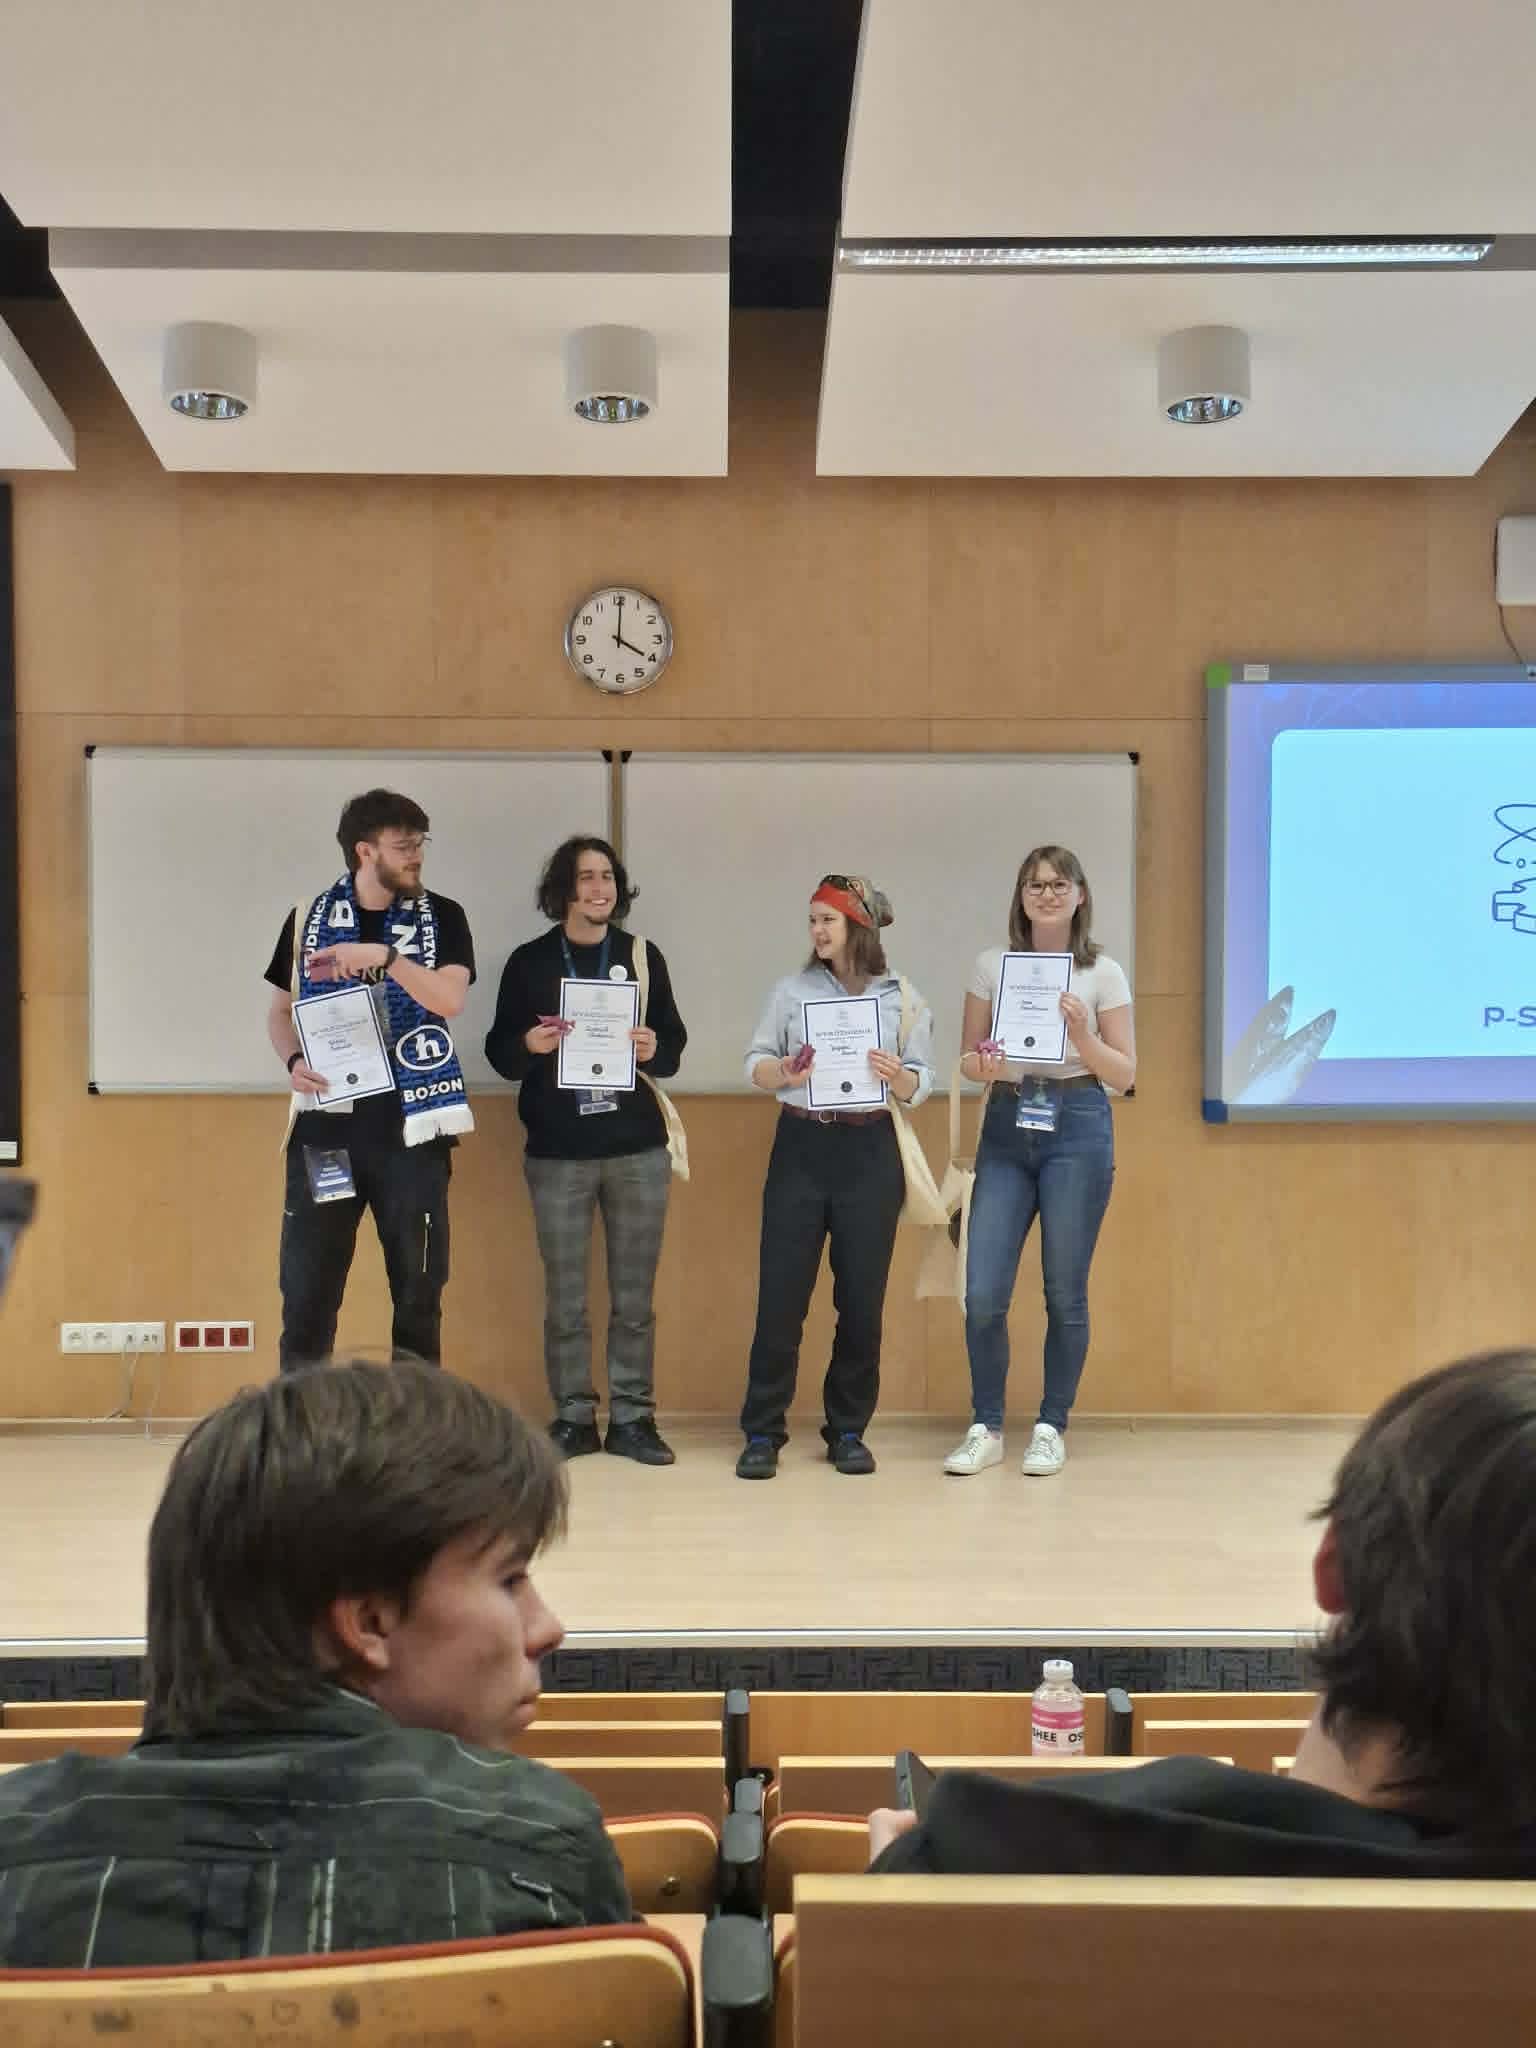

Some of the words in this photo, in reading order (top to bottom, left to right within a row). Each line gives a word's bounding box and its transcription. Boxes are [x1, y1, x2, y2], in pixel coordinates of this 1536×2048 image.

[596, 603, 603, 613] 11
[582, 616, 593, 625] 10
[647, 615, 657, 625] 2
[576, 635, 586, 645] 9
[652, 634, 663, 645] 3
[583, 654, 593, 664] 8
[647, 653, 657, 663] 4
[596, 668, 606, 679] 7
[634, 668, 645, 678] 5
[615, 673, 625, 684] 6
[403, 1077, 464, 1103] BOZON
